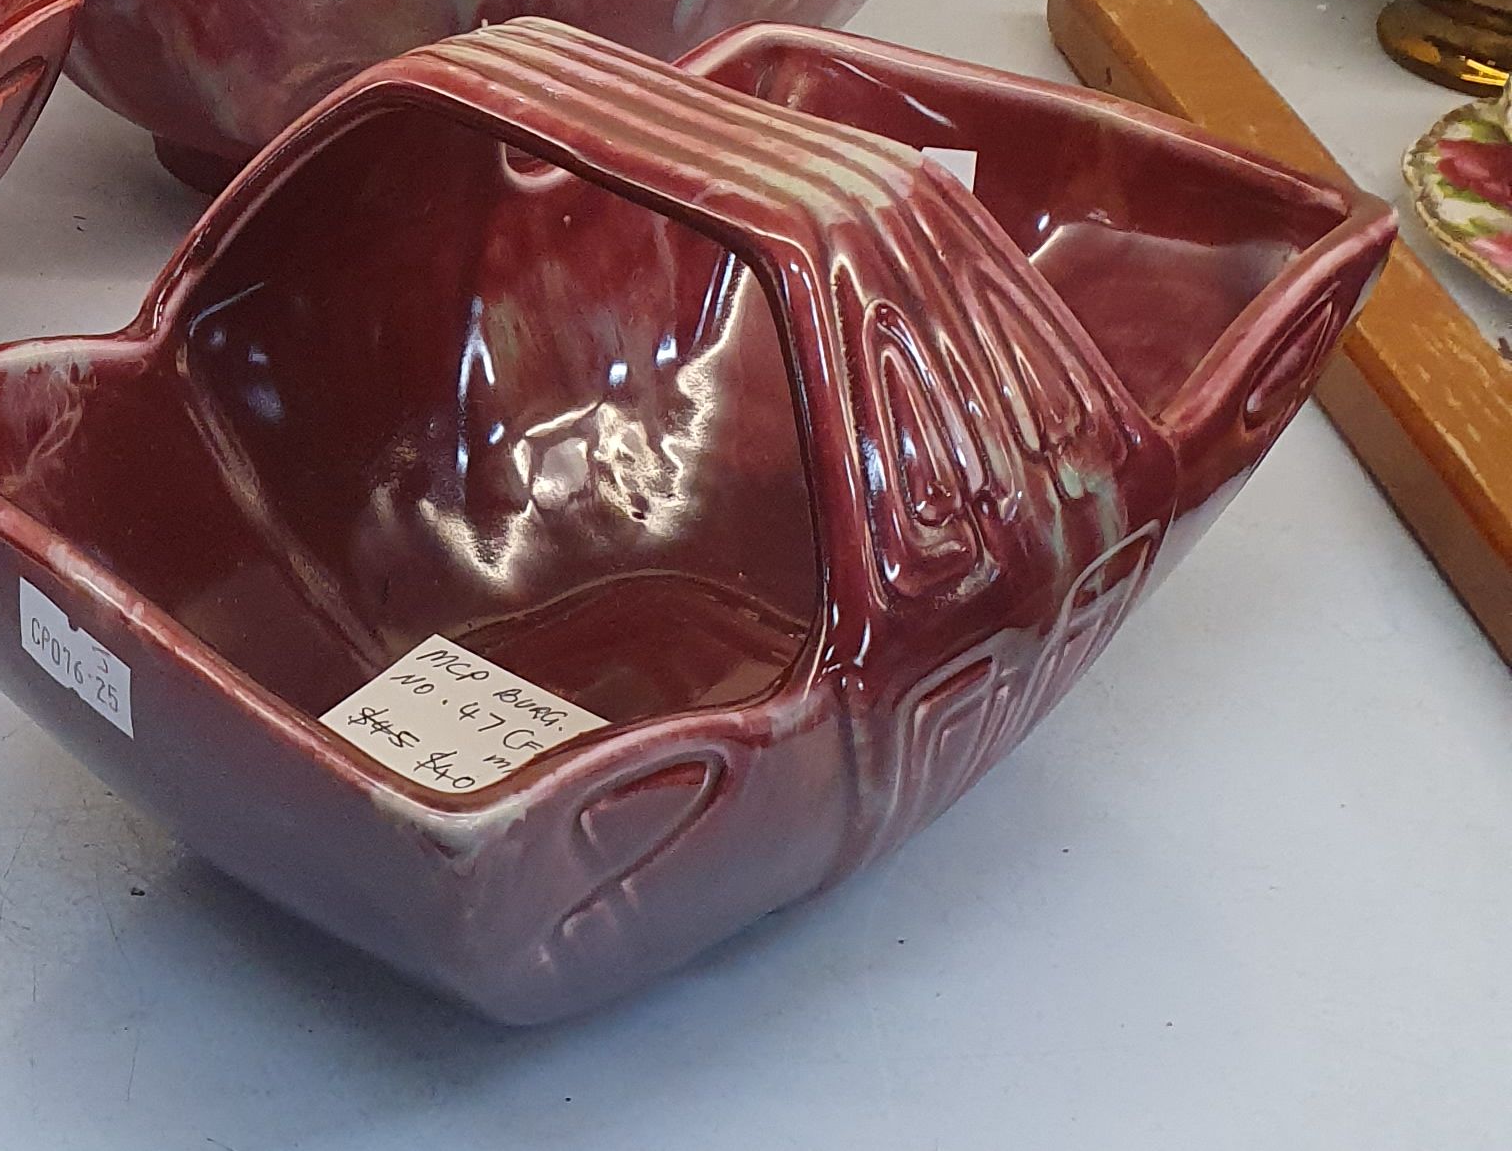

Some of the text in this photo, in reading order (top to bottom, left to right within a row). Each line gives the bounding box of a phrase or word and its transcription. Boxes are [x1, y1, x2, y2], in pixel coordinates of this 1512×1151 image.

[416, 649, 566, 731] MCP BURG.
[414, 751, 476, 789] $40
